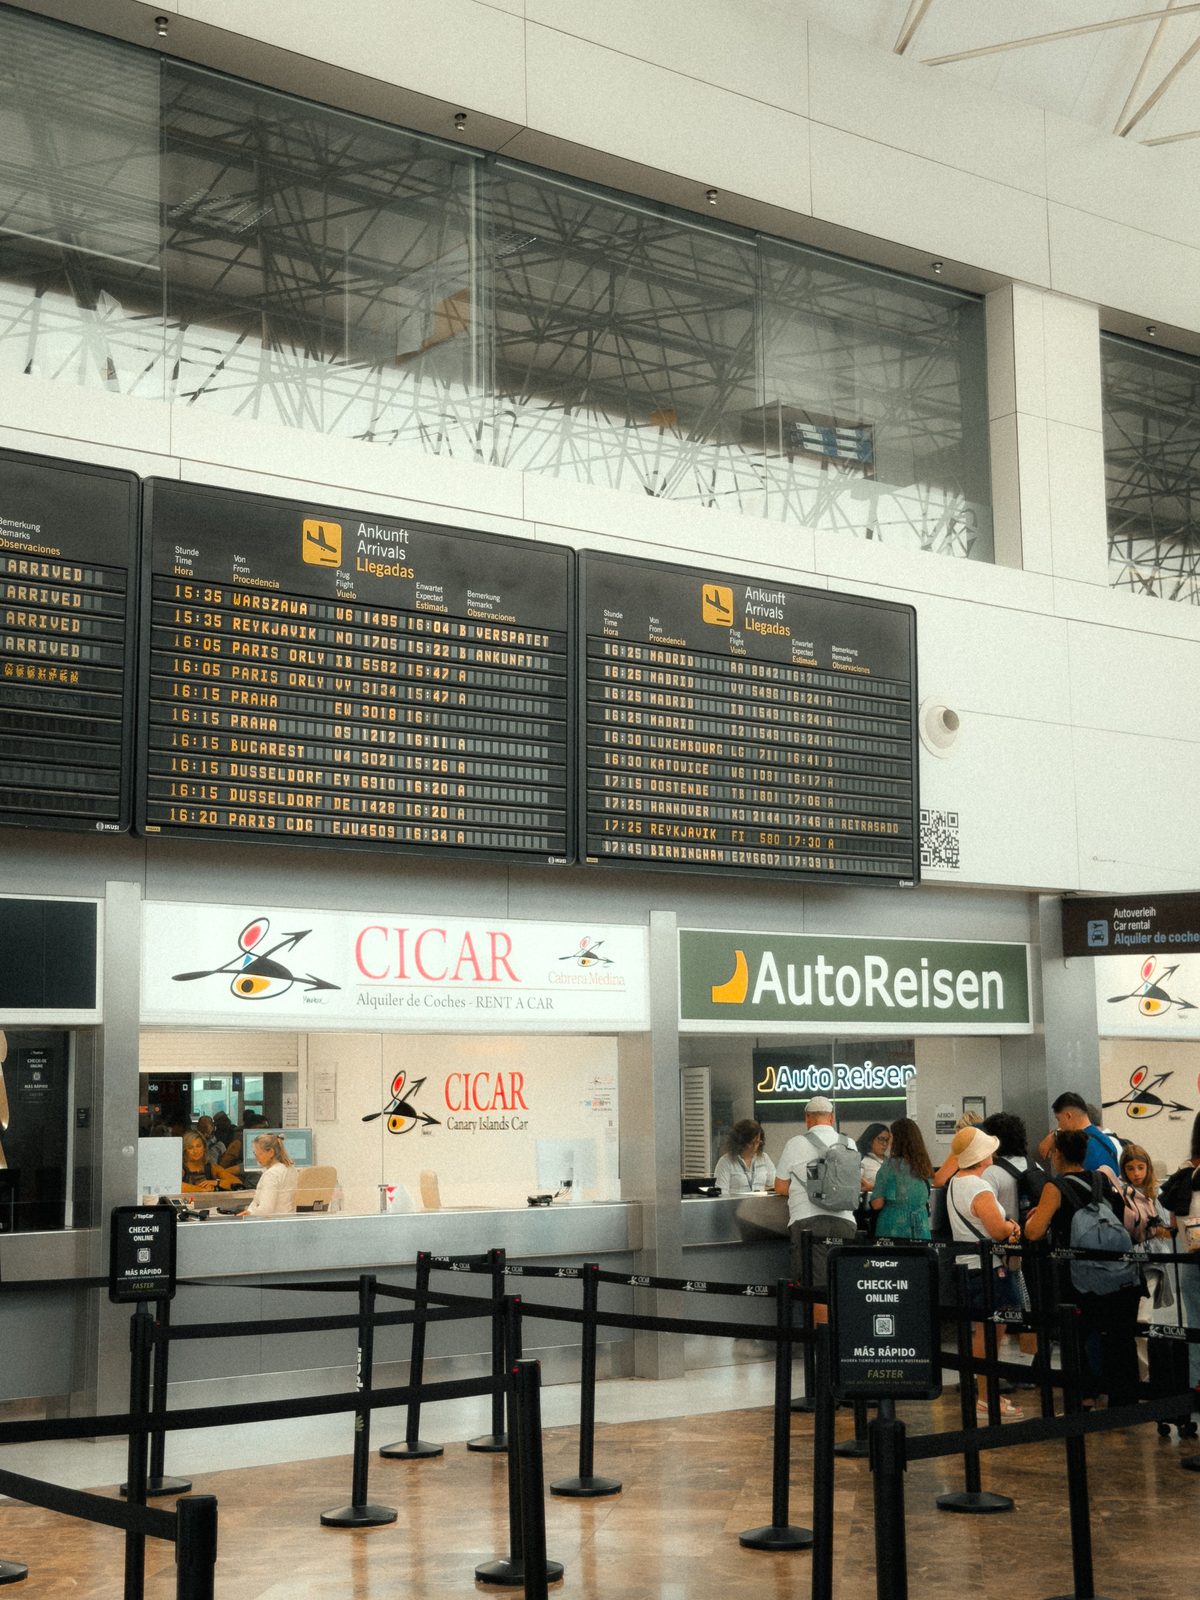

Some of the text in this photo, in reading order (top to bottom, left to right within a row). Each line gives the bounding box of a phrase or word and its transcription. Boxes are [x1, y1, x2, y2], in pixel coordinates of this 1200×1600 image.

[358, 523, 409, 544] Ankunft
[175, 546, 199, 556] Stunde
[357, 540, 406, 560] Arrivals
[176, 556, 192, 565] Time
[234, 555, 246, 563] Von
[8, 560, 82, 581] ARRIVED
[175, 566, 193, 576] Hora
[233, 565, 250, 573] From
[336, 570, 350, 580] Flug
[357, 558, 414, 578] Llegadas
[233, 574, 279, 588] Procedencia
[336, 580, 354, 589] Flight
[8, 586, 80, 607] ARRIVED
[337, 590, 356, 599] Vuelo
[416, 592, 443, 602] Expected
[467, 590, 500, 602] Bemerkung
[745, 587, 785, 605] Ankunft
[416, 602, 448, 612] Estimada
[468, 600, 493, 609] Remarks
[745, 602, 783, 619] Arrivals
[7, 611, 80, 632] ARRIVED
[175, 585, 549, 647] 15:35 WARSZAWA 1495 16:04 VERSPATET
[468, 609, 516, 622] Observaciones
[604, 610, 623, 618] Stunde
[604, 628, 618, 636] Hora
[745, 618, 790, 636] Llegadas
[175, 609, 532, 667] 15:35 REYKJAVIK 1705 15:22 ANKUNFT
[650, 634, 686, 646] Procedencia
[730, 638, 744, 646] Flight
[6, 637, 79, 657] ARRIVED
[730, 646, 746, 655] Vuelo
[792, 647, 813, 656] Expected
[832, 646, 858, 656] Bemerkung
[174, 634, 449, 681] 16:05 PARIS ORLY 5582 15:47
[605, 644, 693, 667] 16:25 MADRID
[792, 656, 817, 666] Estimada
[832, 654, 852, 662] Remarks
[832, 662, 870, 674] Observaciones
[174, 659, 448, 704] 16:05 PARIS ORLY 3134 15:47
[605, 666, 819, 704] 16:25 MADRID 16:24
[173, 683, 396, 721] 16:15 PRAHA EW 3018
[605, 687, 819, 725] 16:25 MADRID 16:24
[173, 708, 448, 750] 16:15 PRAHA 1212 16:11
[605, 709, 820, 745] 16:25 MADRID 16:24
[172, 733, 448, 773] 16:15 BUCAREST W4 3021 15:26
[605, 731, 820, 765] 16:30 LUXEMBOURG 16:41
[172, 758, 448, 797] 16:15 DUSSELDORF EY 6910 16:20
[605, 753, 820, 786] 16:30 KATOWICE 16:17
[605, 775, 820, 806] 17:15 OOSTENDE 17:06
[171, 783, 447, 820] 16:15 DUSSELDORF DE 1428 16:20
[605, 797, 899, 833] 17:25 HANNOVER 17:46 RETRASADO
[171, 808, 447, 844] 16:20 PARIS CDG EJU4509 16:34
[605, 819, 820, 847] 17:25 REYKJAVIK 17:30
[605, 841, 821, 868] 17:45 BIRMINGHAM 17:39
[1114, 907, 1156, 918] Autoverleih
[1114, 920, 1150, 930] Car rental
[1115, 931, 1166, 946] Alquiler de
[355, 926, 521, 982] CICAR
[548, 970, 625, 986] Cabrera Medina
[752, 951, 1004, 1009] AutoReisen
[356, 993, 554, 1010] Alquiler de Coches RENT A CAR
[775, 1061, 917, 1092] AutoReisen
[445, 1072, 528, 1111] CICAR
[447, 1117, 476, 1134] Canary
[479, 1116, 509, 1131] Islands
[511, 1117, 528, 1131] Car
[140, 1267, 162, 1275] RÁPIDO
[871, 1260, 898, 1268] TopCar
[857, 1280, 908, 1289] CHECK-IN
[866, 1294, 899, 1302] ONLINE
[1004, 1312, 1023, 1320] CICAR
[1163, 1326, 1186, 1336] CICAR
[854, 1346, 916, 1356] MÁS RÁPIDO
[868, 1370, 904, 1378] FASTER
